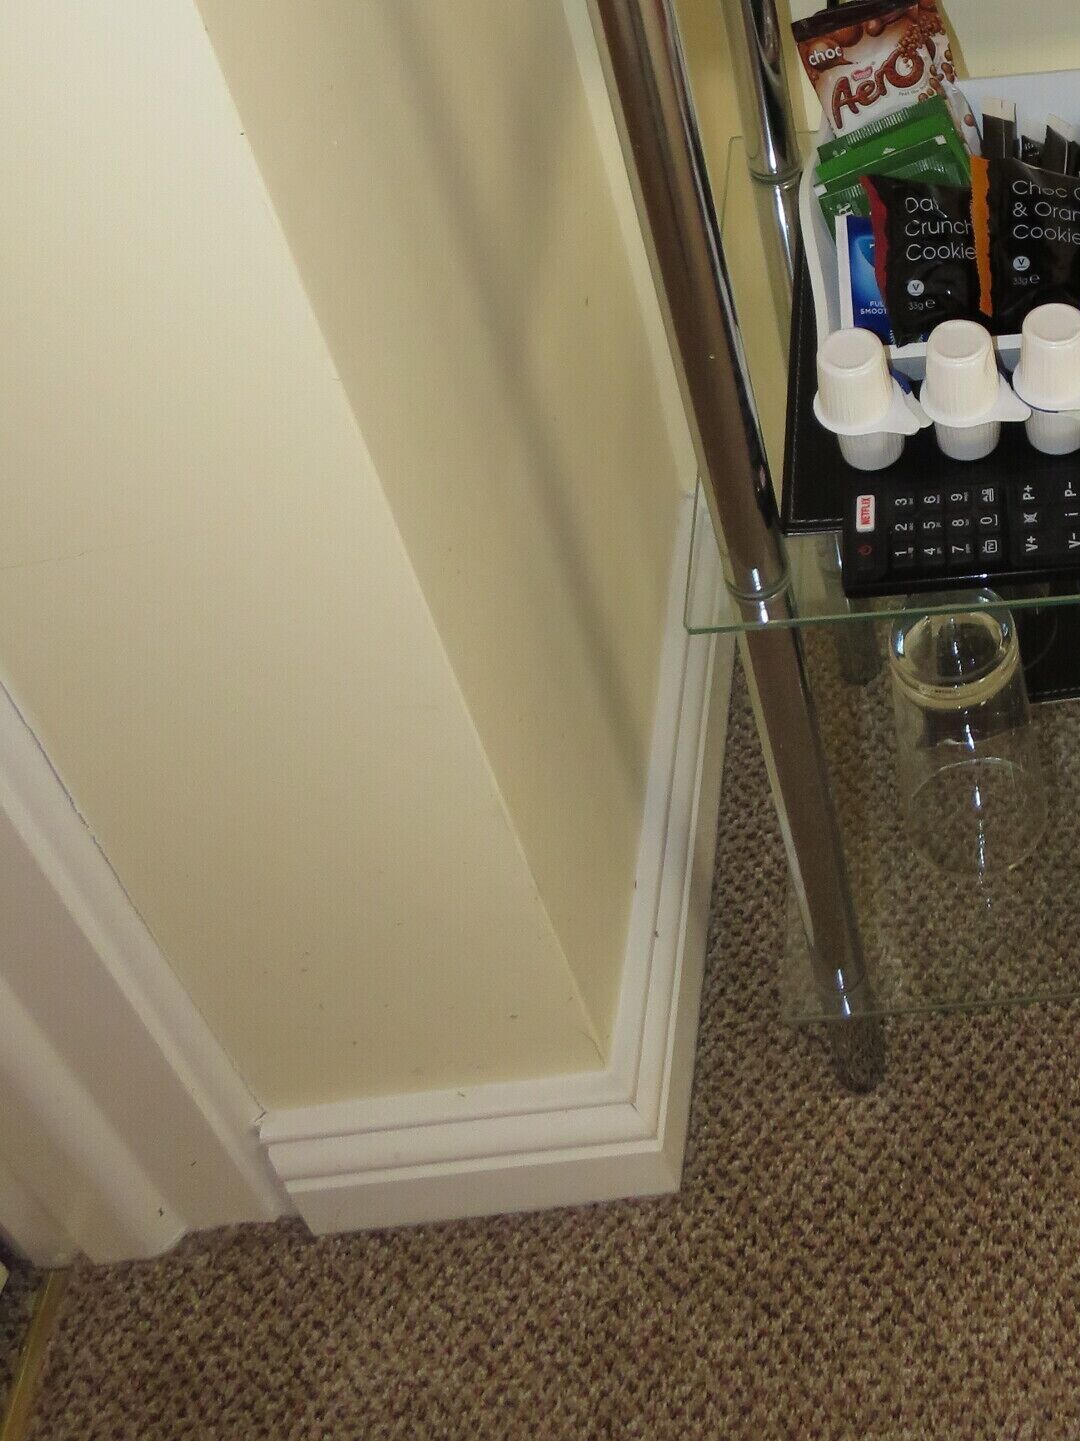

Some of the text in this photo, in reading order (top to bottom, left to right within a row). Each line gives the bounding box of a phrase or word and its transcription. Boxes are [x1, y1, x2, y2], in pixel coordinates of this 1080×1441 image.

[808, 45, 842, 67] choc
[1012, 181, 1068, 198] Choc
[1012, 202, 1028, 217] &
[905, 219, 972, 237] Crunch
[950, 493, 963, 502] 9
[1022, 485, 1035, 501] P+
[895, 498, 907, 506] 3
[924, 495, 936, 504] 6
[861, 497, 872, 525] NETFLIX
[952, 519, 965, 527] 8
[980, 516, 993, 525] 0
[895, 523, 907, 532] 2
[923, 521, 936, 530] 5
[1025, 536, 1039, 552] V+
[924, 547, 936, 555] 4
[952, 545, 965, 553] 7
